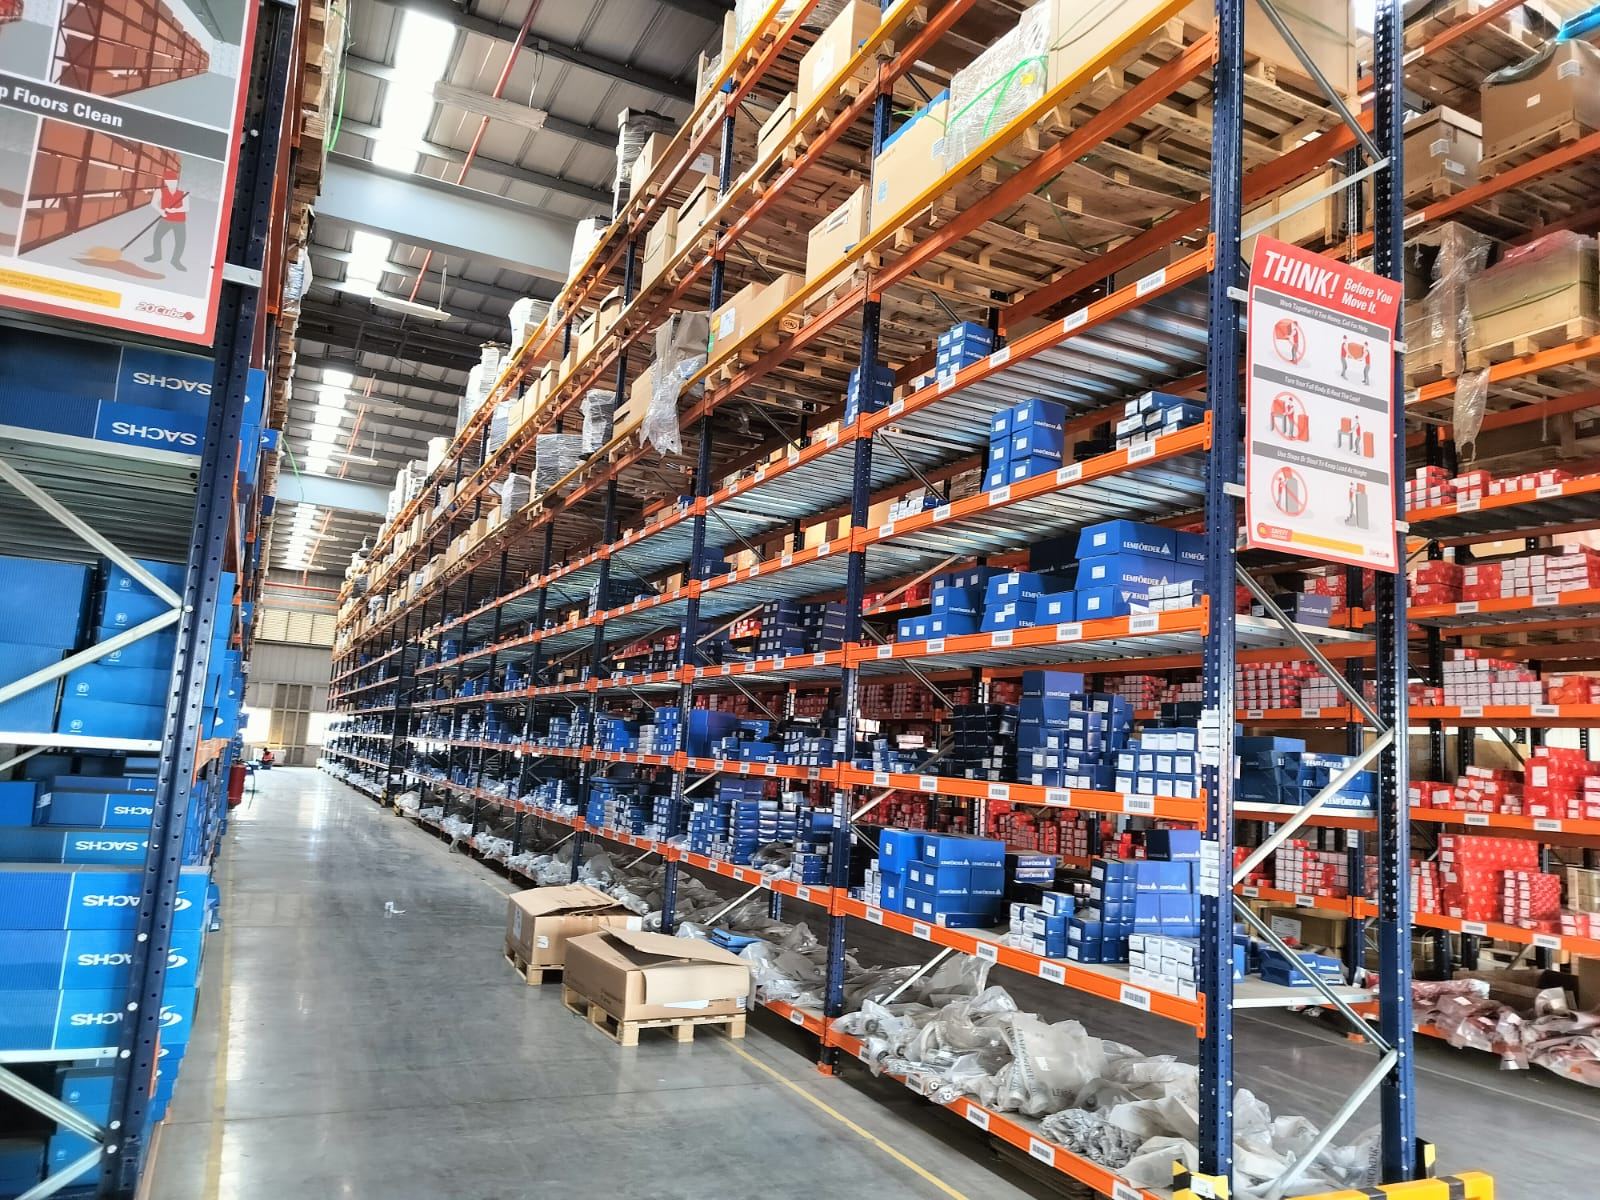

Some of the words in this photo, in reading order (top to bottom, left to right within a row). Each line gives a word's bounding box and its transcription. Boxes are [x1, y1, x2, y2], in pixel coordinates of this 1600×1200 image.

[13, 86, 69, 113] Floors
[73, 102, 123, 127] Clean
[1263, 250, 1340, 298] THINK!
[1344, 277, 1374, 299] Before
[1376, 288, 1393, 305] You
[1341, 292, 1367, 311] Move
[132, 372, 212, 396] SACHS
[111, 421, 198, 446] SACHS
[1123, 541, 1161, 553] LEMFÖRDER
[113, 805, 153, 816] ACHS
[75, 840, 138, 851] SACHS
[82, 894, 141, 907] ACHS
